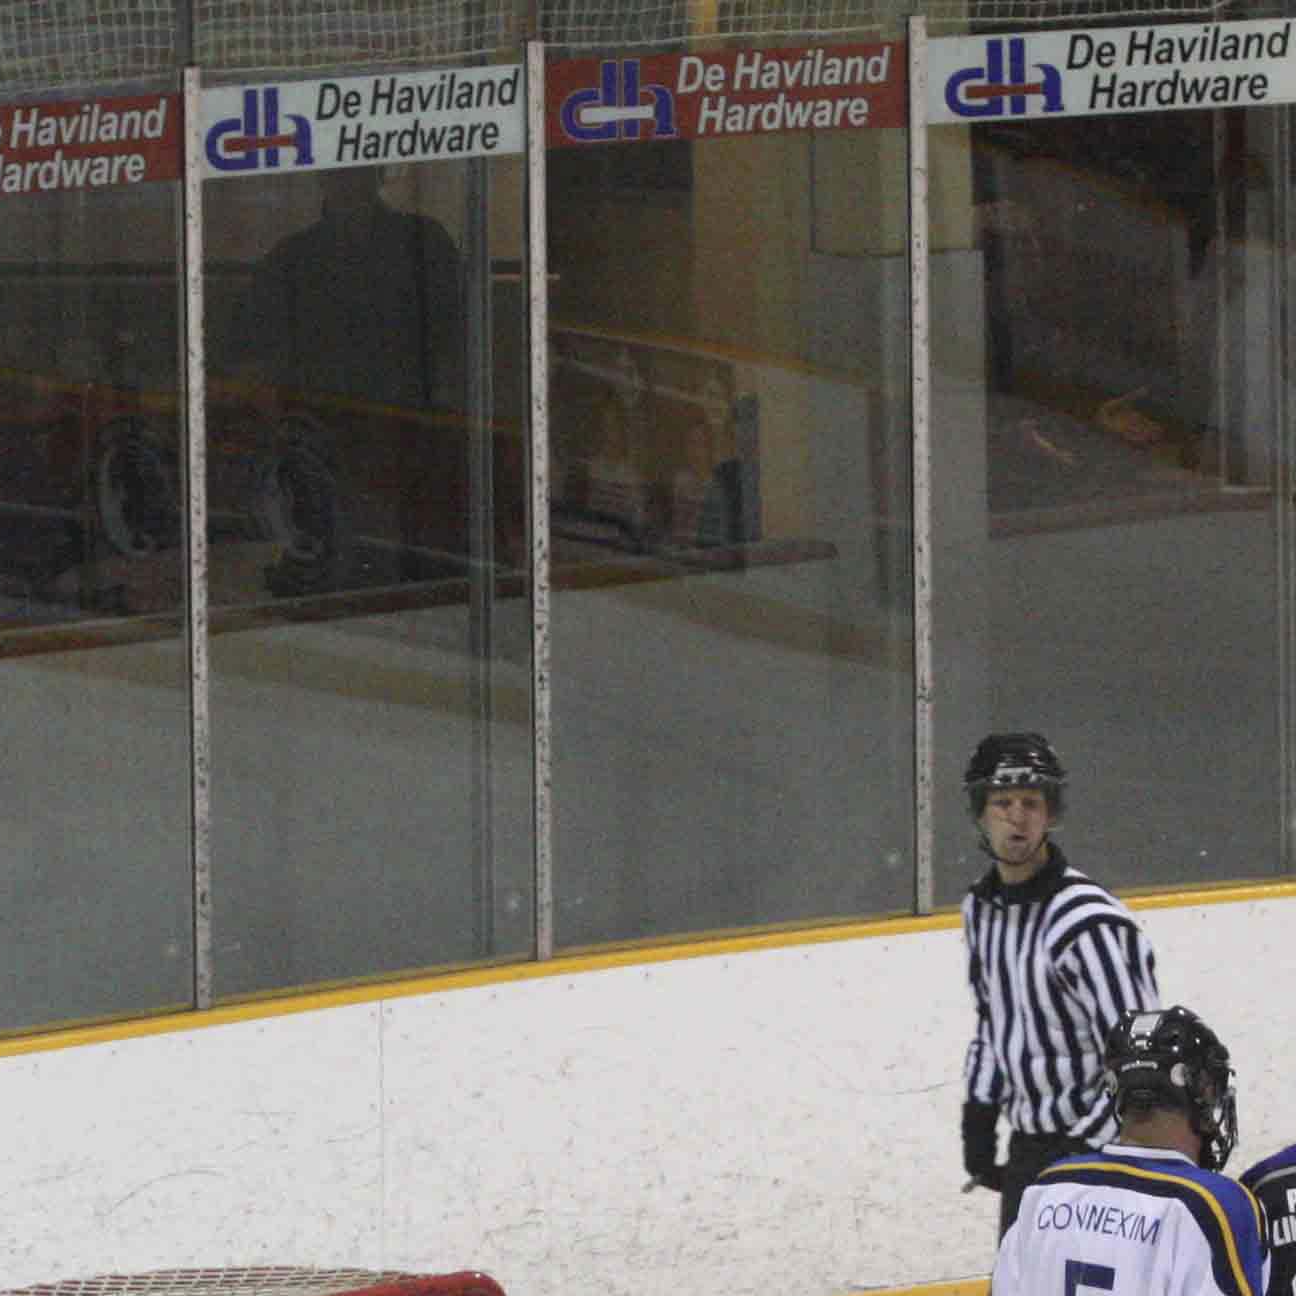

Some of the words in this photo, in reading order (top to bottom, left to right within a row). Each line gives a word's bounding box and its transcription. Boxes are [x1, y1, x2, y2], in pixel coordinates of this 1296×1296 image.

[677, 54, 724, 92] De
[734, 46, 890, 89] Haviland
[1067, 32, 1115, 71] De
[1125, 23, 1291, 68] Haviland
[316, 82, 363, 121] De
[371, 68, 519, 118] Haviland
[1088, 69, 1269, 111] Hardware
[10, 99, 167, 148] Haviland
[698, 94, 868, 135] Hardware
[336, 118, 499, 163] Hardware
